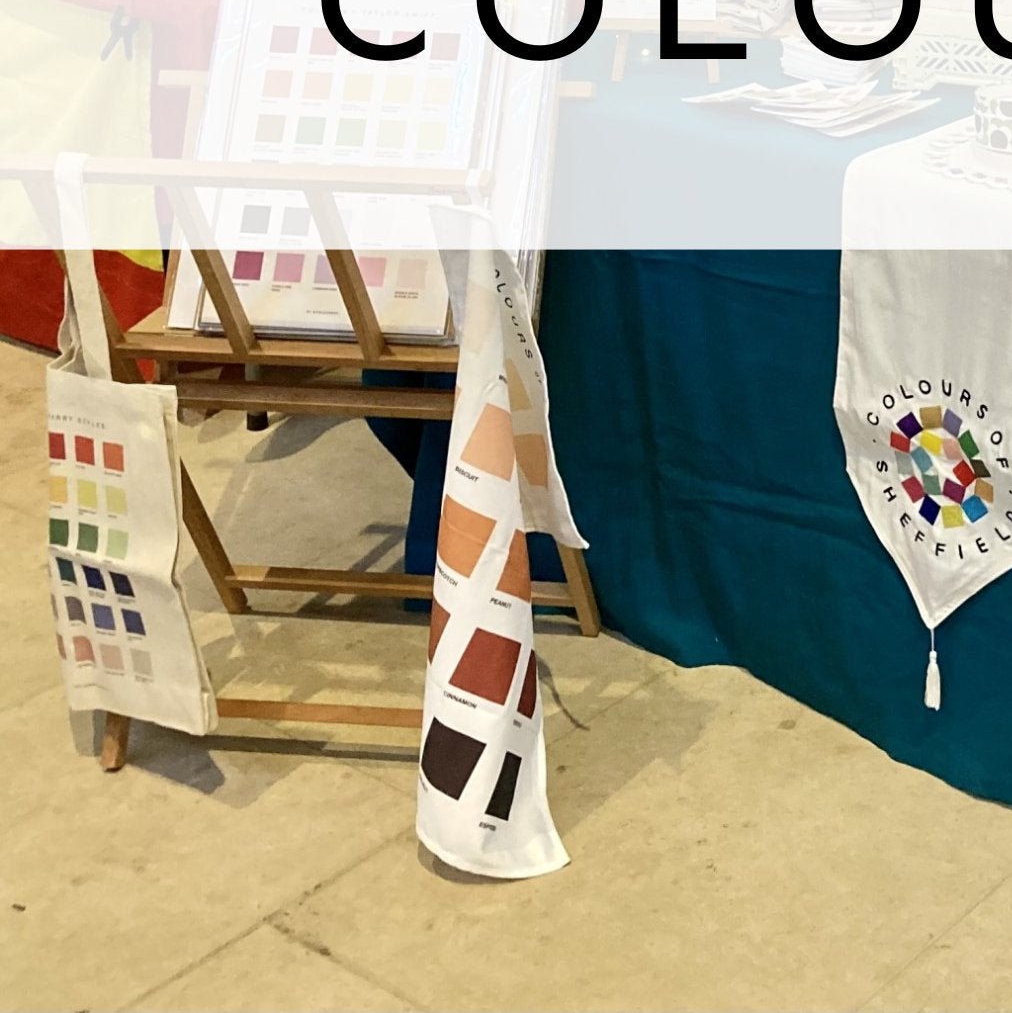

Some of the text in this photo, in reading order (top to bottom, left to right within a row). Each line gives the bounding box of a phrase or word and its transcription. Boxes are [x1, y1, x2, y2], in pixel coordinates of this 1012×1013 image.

[867, 379, 1009, 468] COLOURS OF
[455, 466, 479, 482] BISCUIT
[489, 597, 512, 610] PEANUT
[444, 690, 477, 708] CINNAMON
